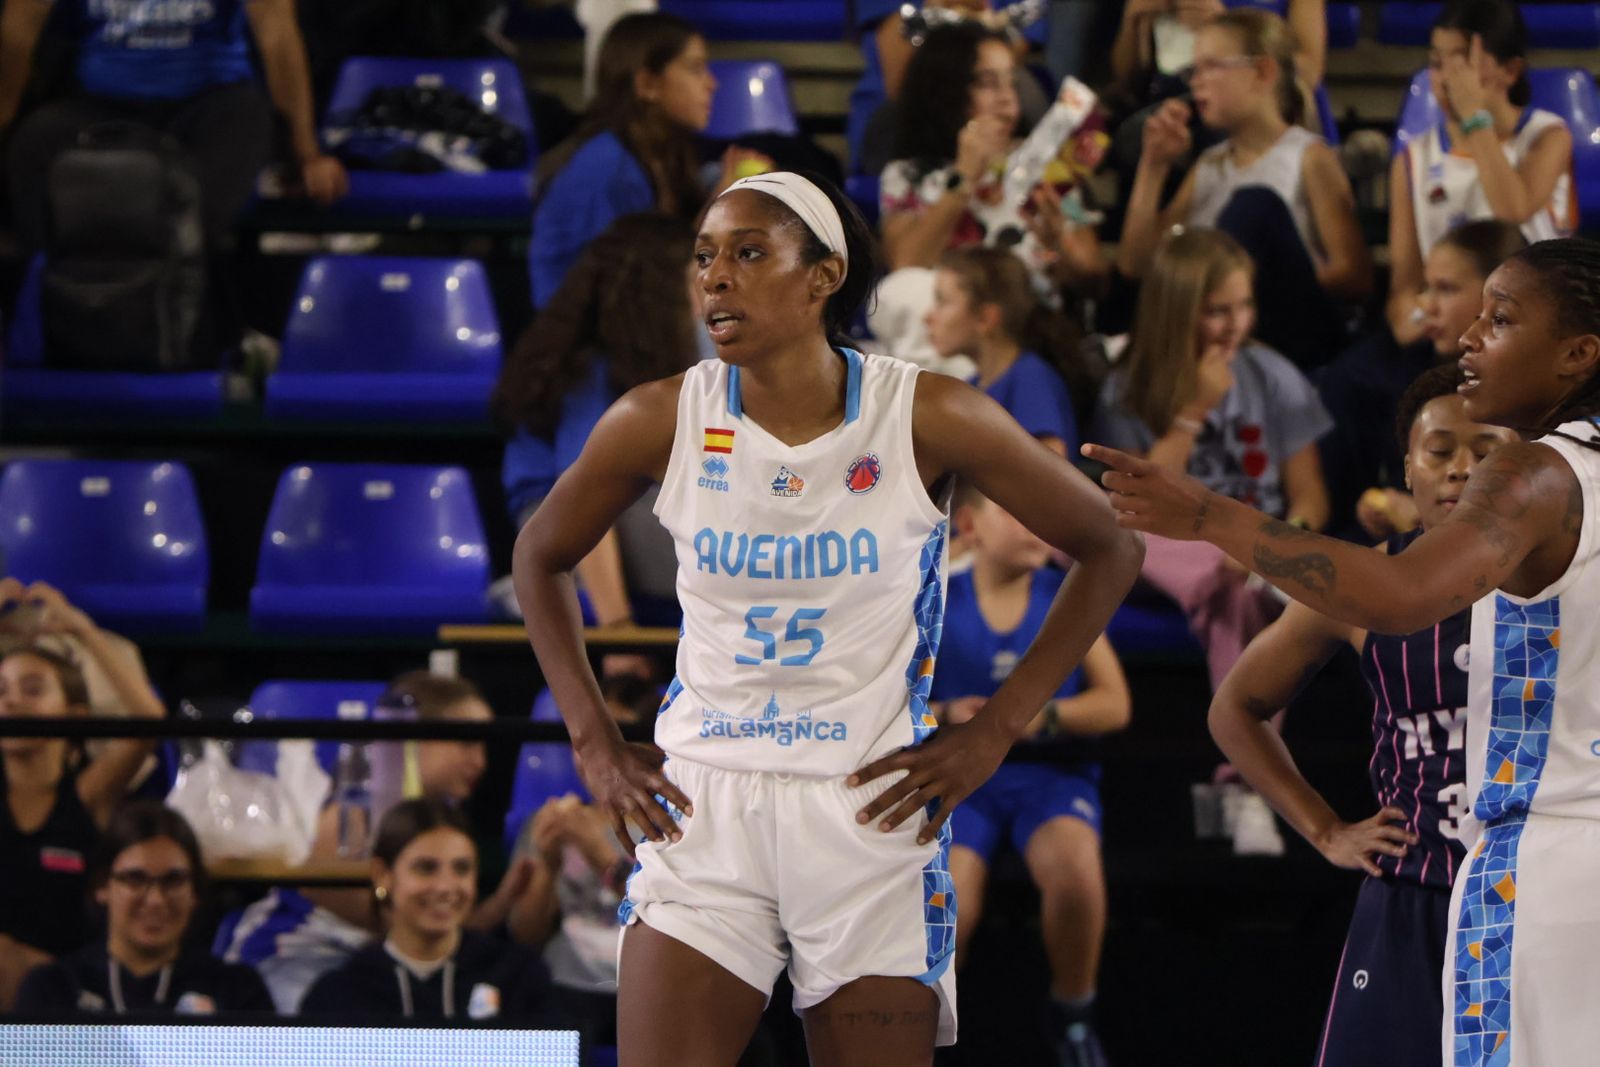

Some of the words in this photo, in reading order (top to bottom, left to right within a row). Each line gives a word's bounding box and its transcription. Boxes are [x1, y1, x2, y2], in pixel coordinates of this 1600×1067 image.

[770, 488, 803, 497] AVENIDA
[694, 527, 879, 580] AVENIDA
[735, 606, 828, 666] 55
